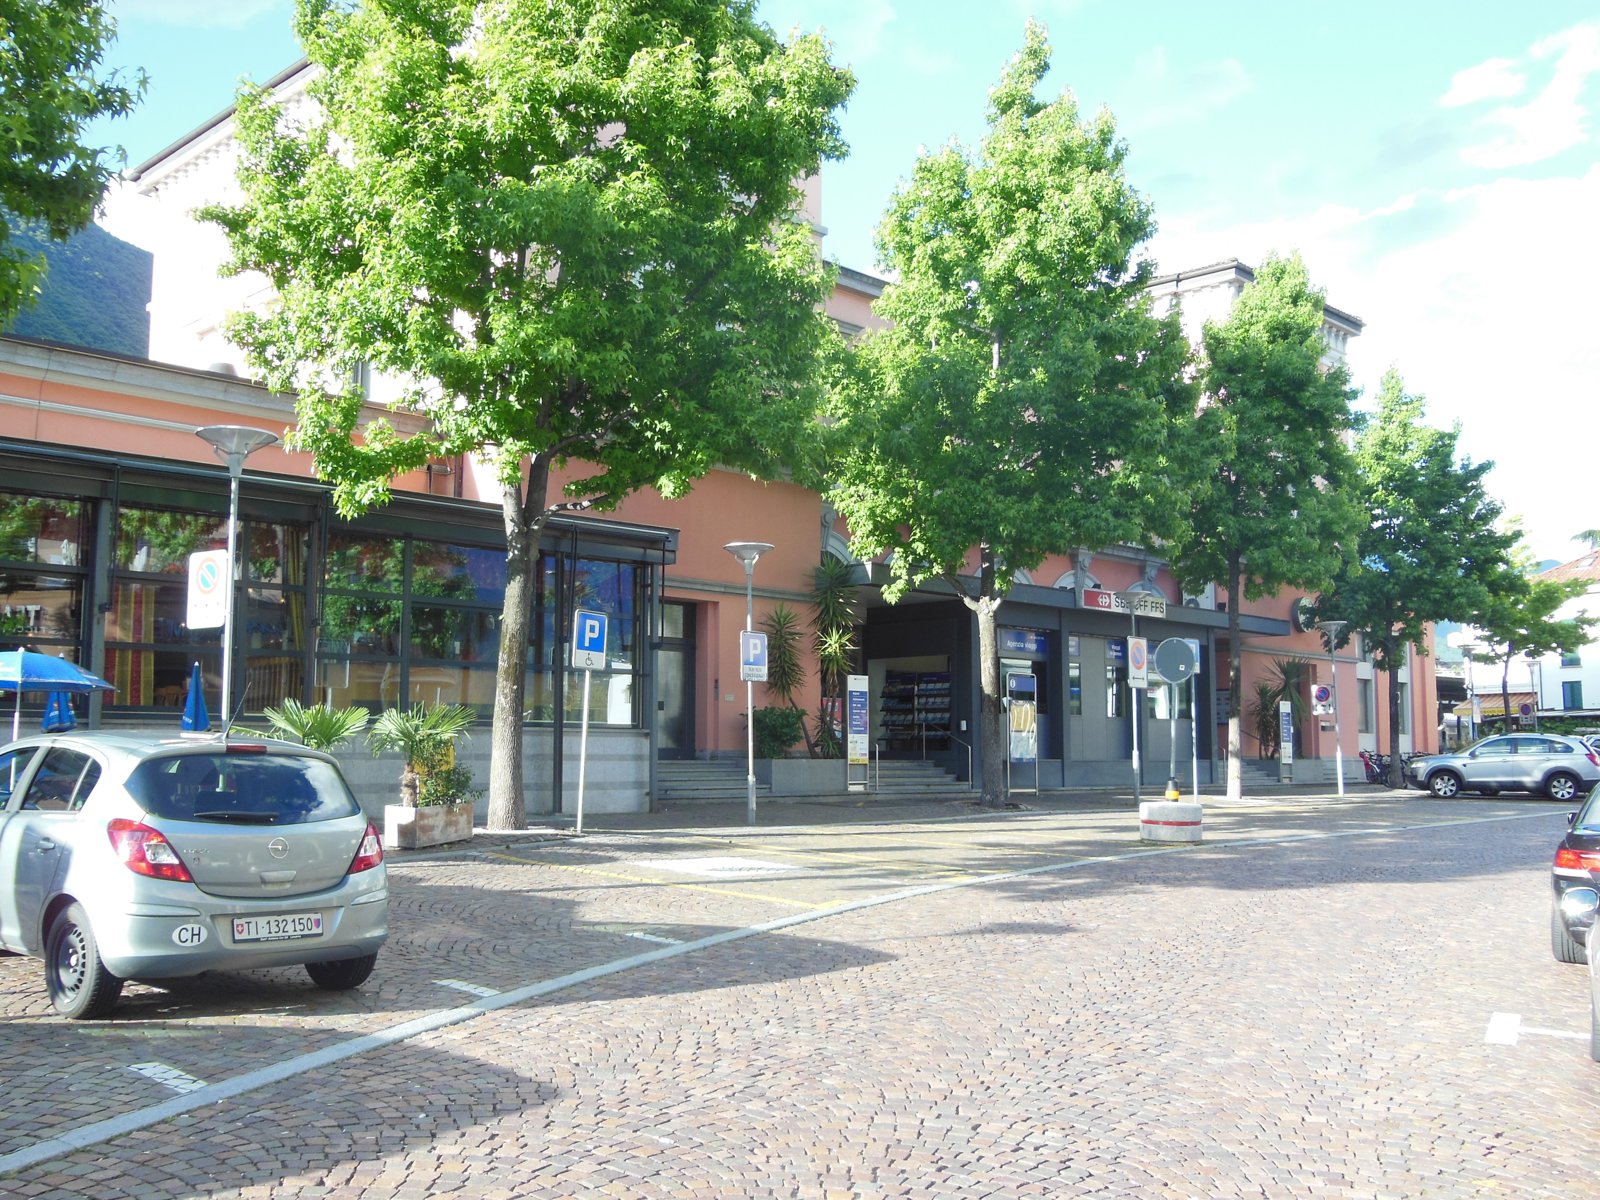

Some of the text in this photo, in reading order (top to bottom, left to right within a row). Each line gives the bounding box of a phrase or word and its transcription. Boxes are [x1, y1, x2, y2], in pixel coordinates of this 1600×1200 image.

[1151, 601, 1165, 614] FFS
[584, 619, 600, 647] P
[749, 638, 761, 663] P
[178, 927, 201, 944] CH
